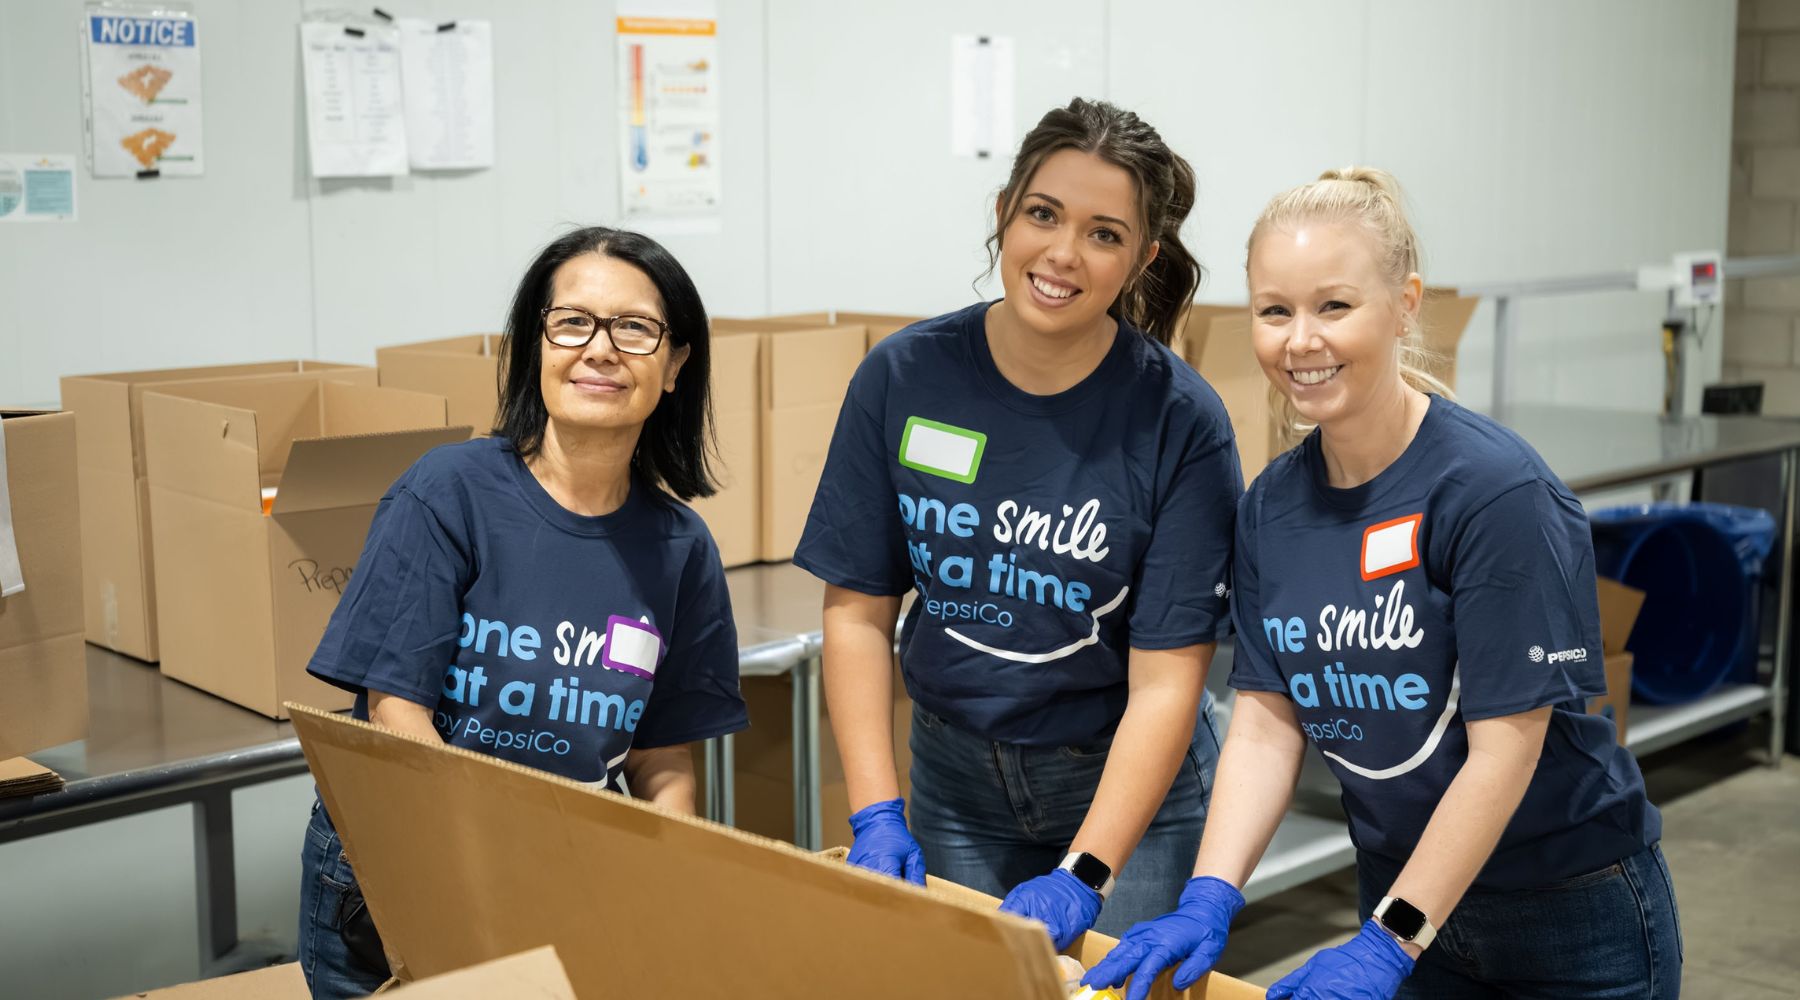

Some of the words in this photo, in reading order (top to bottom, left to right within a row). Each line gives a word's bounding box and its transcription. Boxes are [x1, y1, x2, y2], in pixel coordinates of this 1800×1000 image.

[101, 19, 187, 45] NOTICE
[898, 493, 980, 538] one
[993, 498, 1110, 562] smile
[938, 555, 974, 589] a
[988, 553, 1092, 612] time
[457, 612, 542, 661] one
[926, 599, 1013, 628] epsiCo
[1262, 616, 1307, 653] ne
[1317, 579, 1425, 651] smile
[1547, 647, 1587, 665] PEPSICO
[441, 665, 488, 707] at
[498, 680, 536, 717] a
[548, 676, 645, 733] time
[1289, 673, 1320, 708] a
[1323, 661, 1430, 711] time
[463, 717, 570, 756] PepsiCo
[1301, 718, 1363, 743] epsiCo
